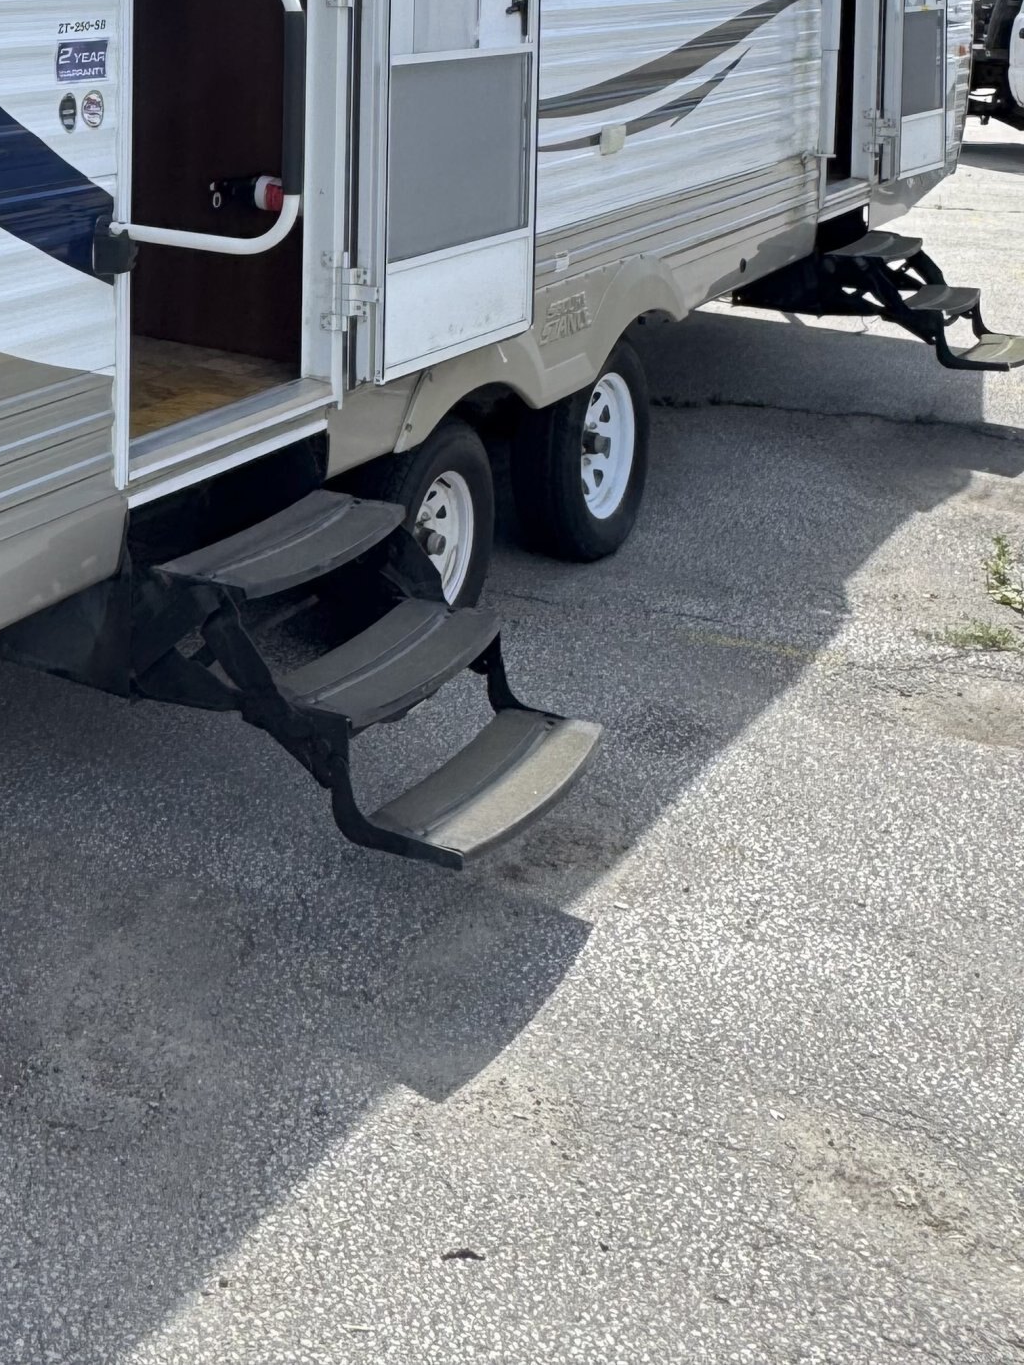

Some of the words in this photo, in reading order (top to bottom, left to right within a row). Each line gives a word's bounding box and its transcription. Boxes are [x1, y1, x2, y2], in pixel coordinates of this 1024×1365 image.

[58, 47, 73, 65] 2
[73, 51, 106, 64] YEAR
[58, 66, 105, 78] WARRANTY
